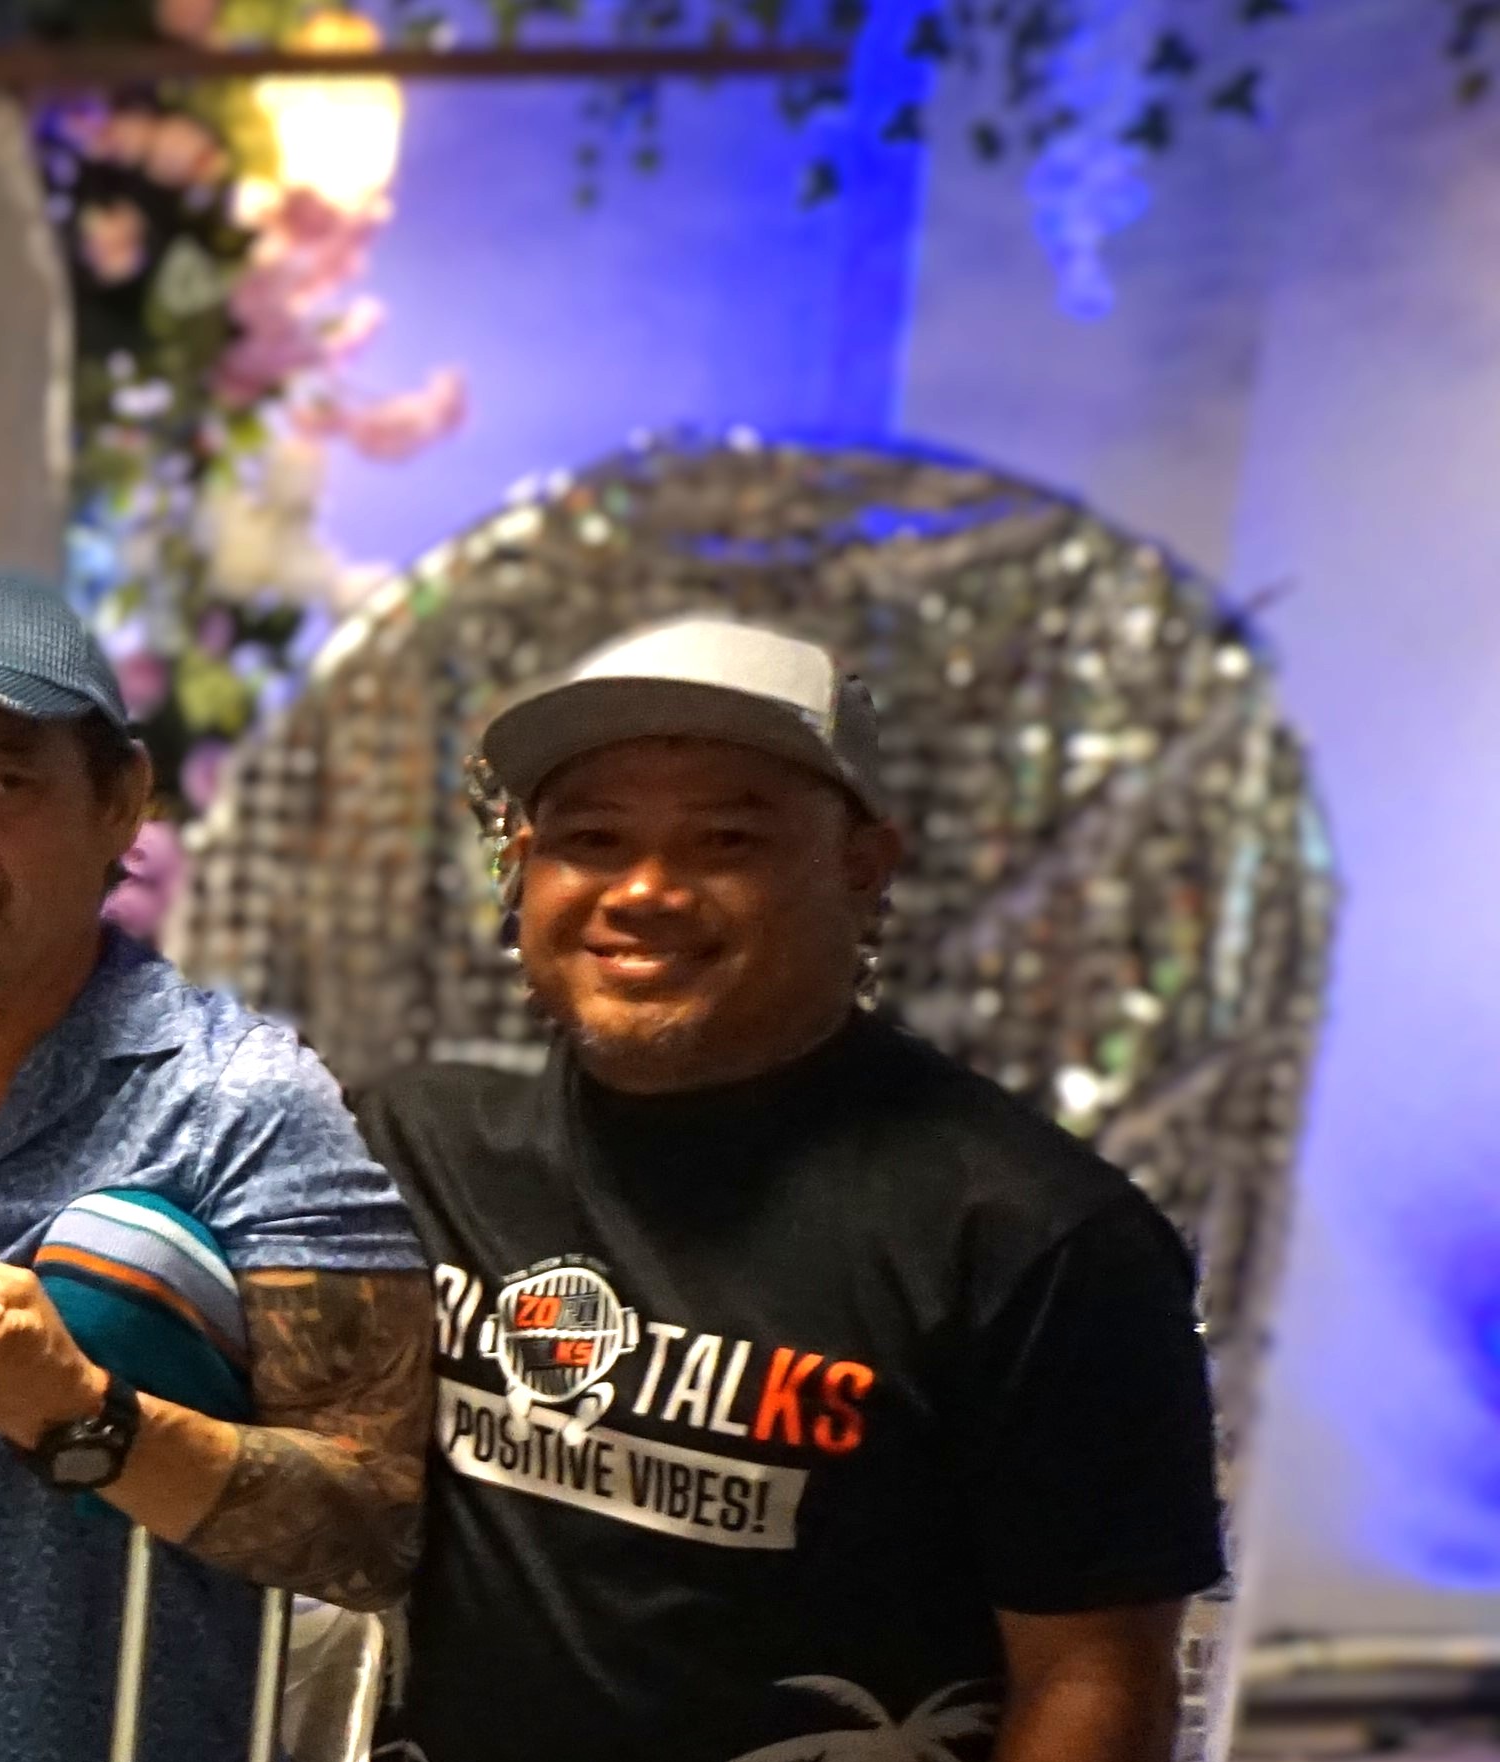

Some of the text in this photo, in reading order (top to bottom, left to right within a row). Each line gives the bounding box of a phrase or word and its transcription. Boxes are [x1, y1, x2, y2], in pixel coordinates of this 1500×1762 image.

[632, 1321, 875, 1454] TALKS
[451, 1398, 770, 1534] POSITIVE VIBES!
